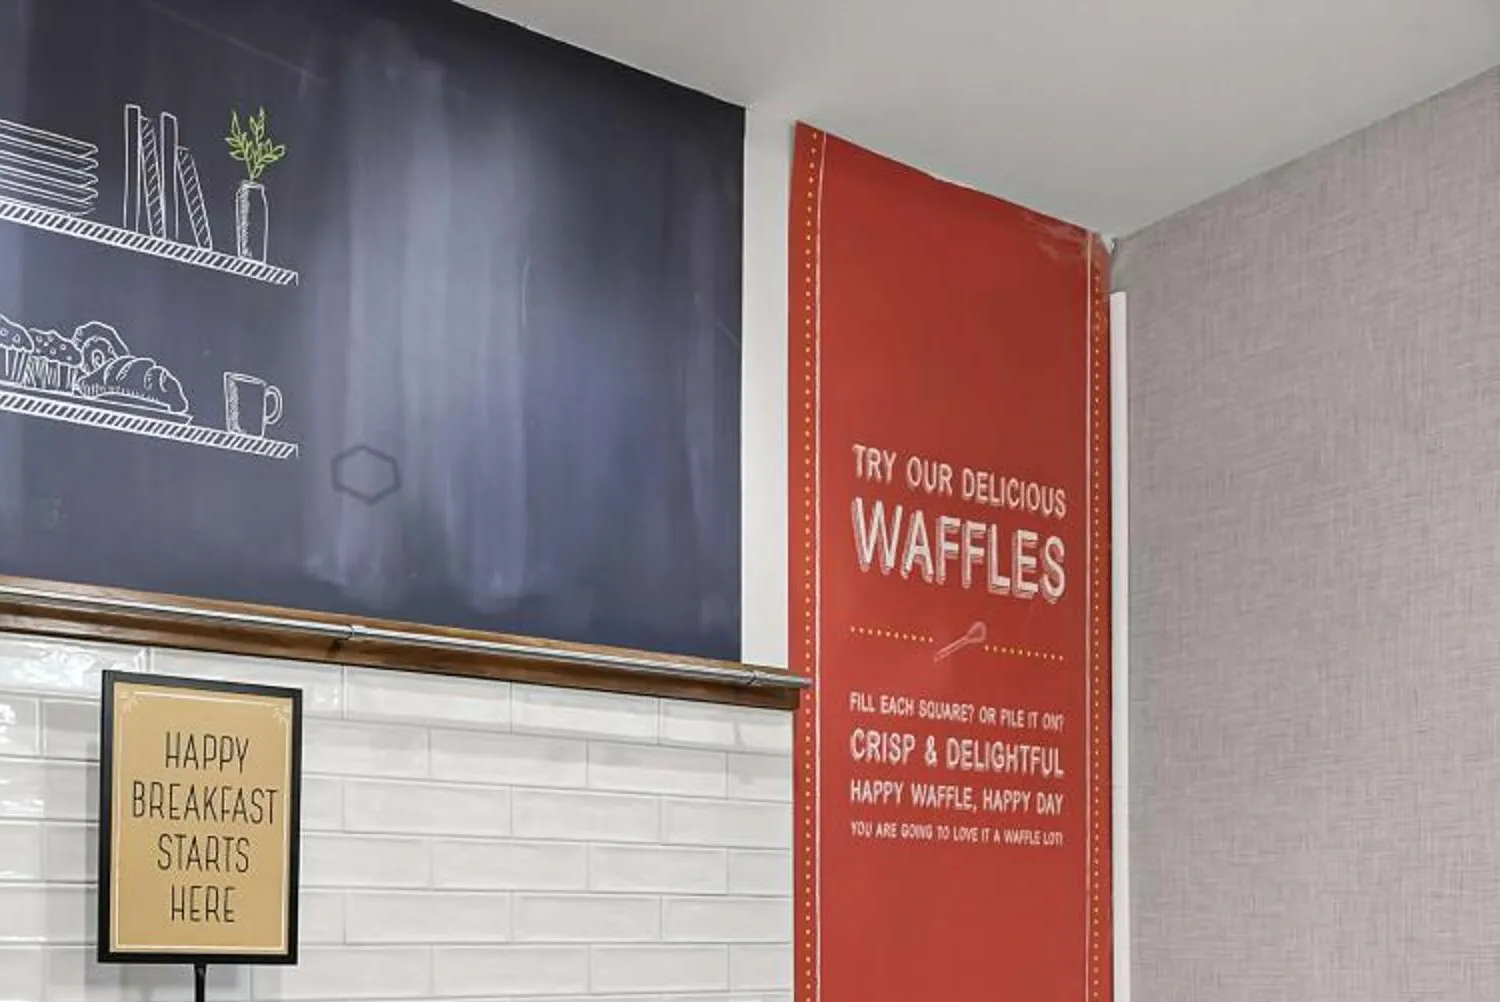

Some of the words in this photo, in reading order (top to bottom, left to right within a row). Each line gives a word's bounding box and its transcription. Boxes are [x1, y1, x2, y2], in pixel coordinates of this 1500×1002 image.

[852, 444, 897, 485] TRY
[906, 455, 953, 496] OUR
[961, 467, 1068, 519] DELICIOUS
[851, 496, 1067, 605] WAFFLES
[850, 691, 876, 713] FILL
[880, 695, 914, 717] EACH
[918, 699, 975, 723] SQUARE?
[979, 706, 997, 726] OR
[1001, 708, 1025, 729] PILE
[1028, 711, 1038, 729] IT
[166, 731, 249, 773] HAPPY
[851, 727, 916, 765] CRISP
[924, 735, 938, 768] &
[946, 737, 1065, 778] DELIGHTFUL
[132, 780, 278, 825] BREAKFAST
[851, 779, 904, 805] HAPPY
[911, 783, 977, 814] WAFFLE,
[983, 788, 1032, 813] HAPPY
[1036, 791, 1064, 816] DAY
[157, 833, 250, 873] STARTS
[851, 820, 872, 837] YOU
[875, 822, 897, 839] ARE
[901, 823, 933, 840] GOING
[937, 825, 950, 840] TO
[953, 826, 979, 843] LOVE
[981, 827, 991, 843] IT
[993, 828, 1001, 843] A
[1004, 829, 1041, 846] WAFFLE
[171, 884, 236, 922] HERE
